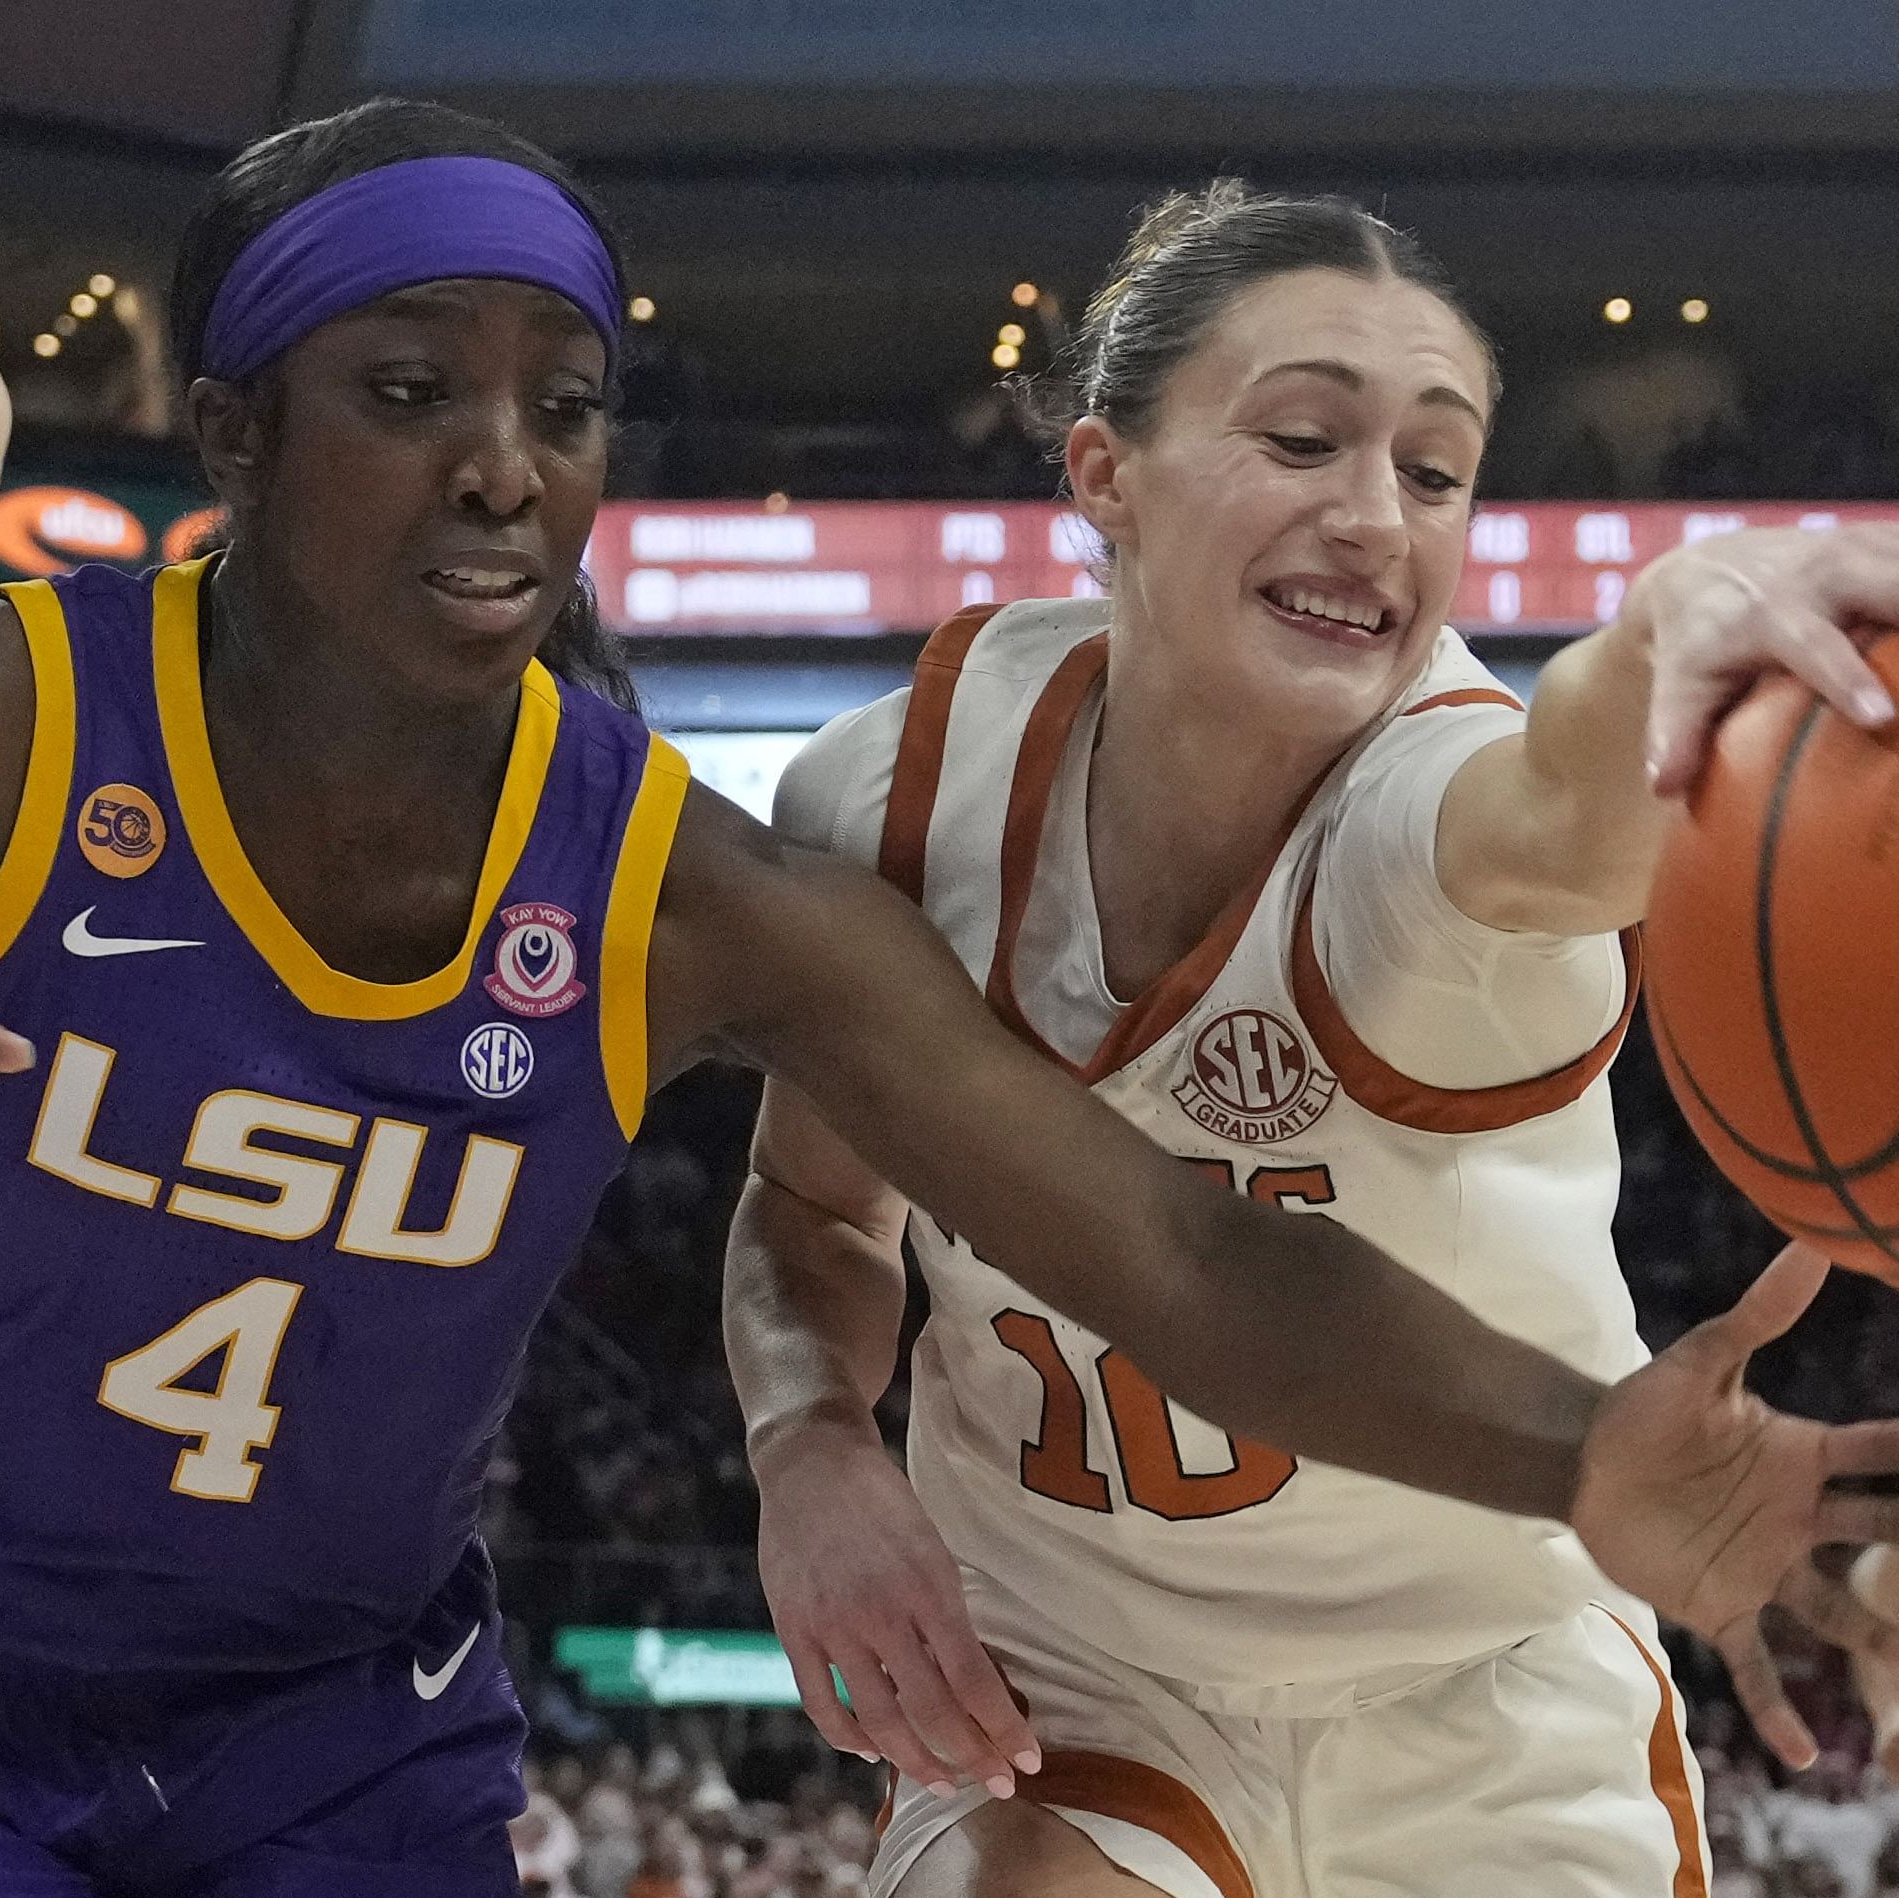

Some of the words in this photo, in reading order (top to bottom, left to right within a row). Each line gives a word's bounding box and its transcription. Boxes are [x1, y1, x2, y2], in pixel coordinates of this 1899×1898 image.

[508, 907, 534, 926] KAY
[538, 907, 569, 927] YOW
[491, 983, 536, 1013] SERVANT
[539, 990, 577, 1014] LEADER
[468, 1028, 527, 1091] SEC
[1199, 1014, 1301, 1109] SEC
[26, 1031, 526, 1268] LSU
[1195, 1097, 1320, 1141] GRADUATE
[97, 1276, 306, 1504] 4
